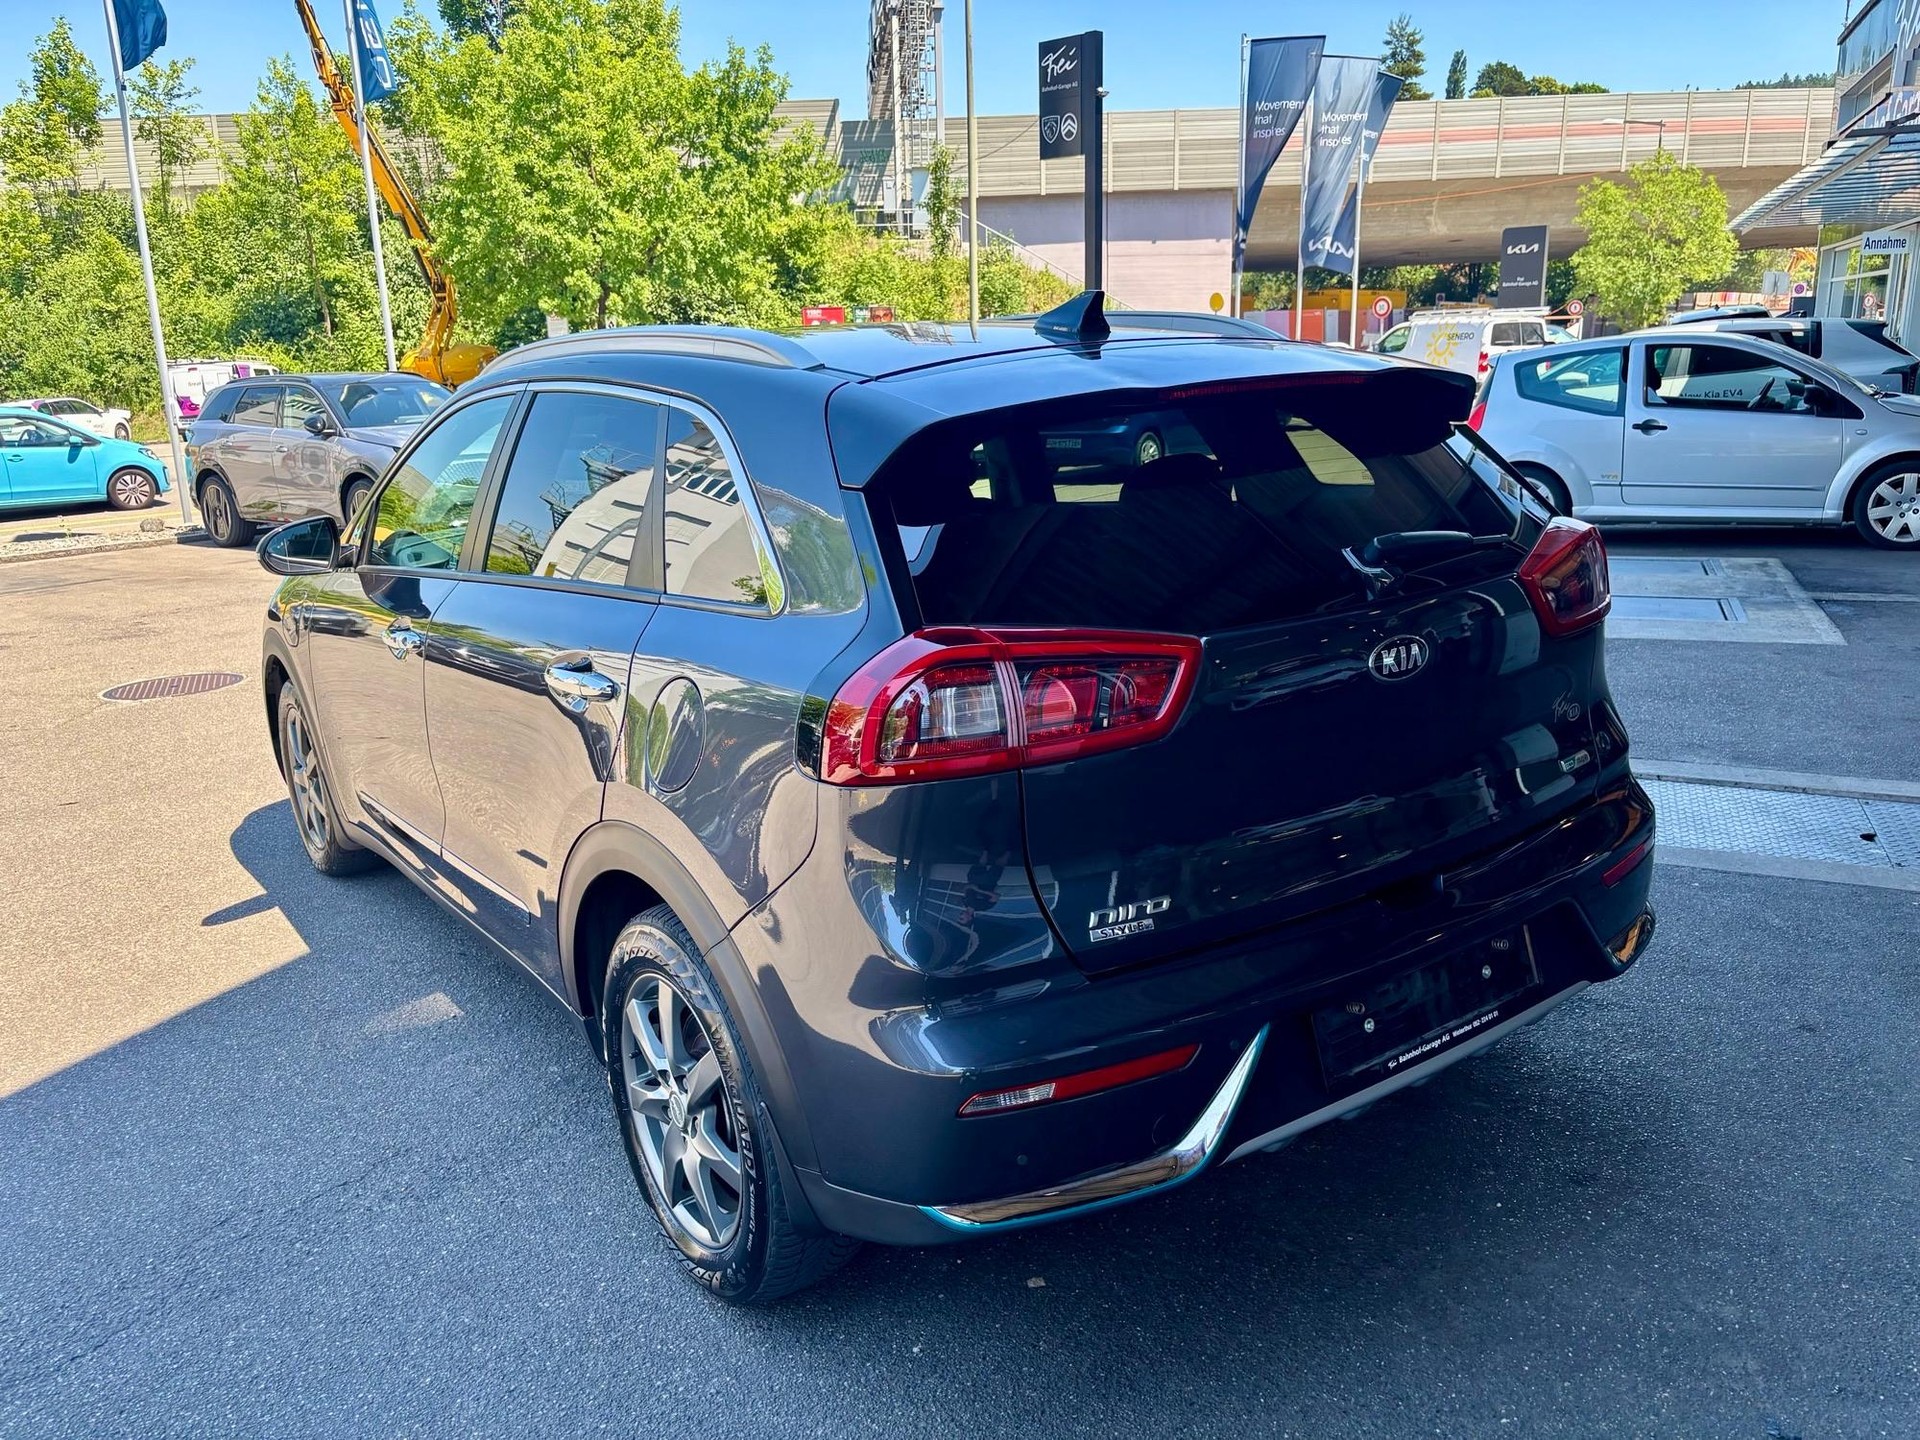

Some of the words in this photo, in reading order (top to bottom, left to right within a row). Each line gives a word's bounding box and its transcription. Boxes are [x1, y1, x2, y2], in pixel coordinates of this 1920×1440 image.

[1255, 100, 1305, 112] Movement
[1255, 114, 1273, 125] that
[1321, 112, 1368, 123] Movement
[1321, 125, 1340, 135] that
[1507, 243, 1539, 255] KIA
[1864, 236, 1907, 250] Annahme
[1704, 391, 1719, 399] Kia
[1723, 388, 1743, 398] EV4
[1381, 643, 1422, 675] KIA
[1100, 920, 1145, 938] STYLE
[1398, 1039, 1441, 1063] Bahnhof-Garage
[1441, 1033, 1450, 1043] AG
